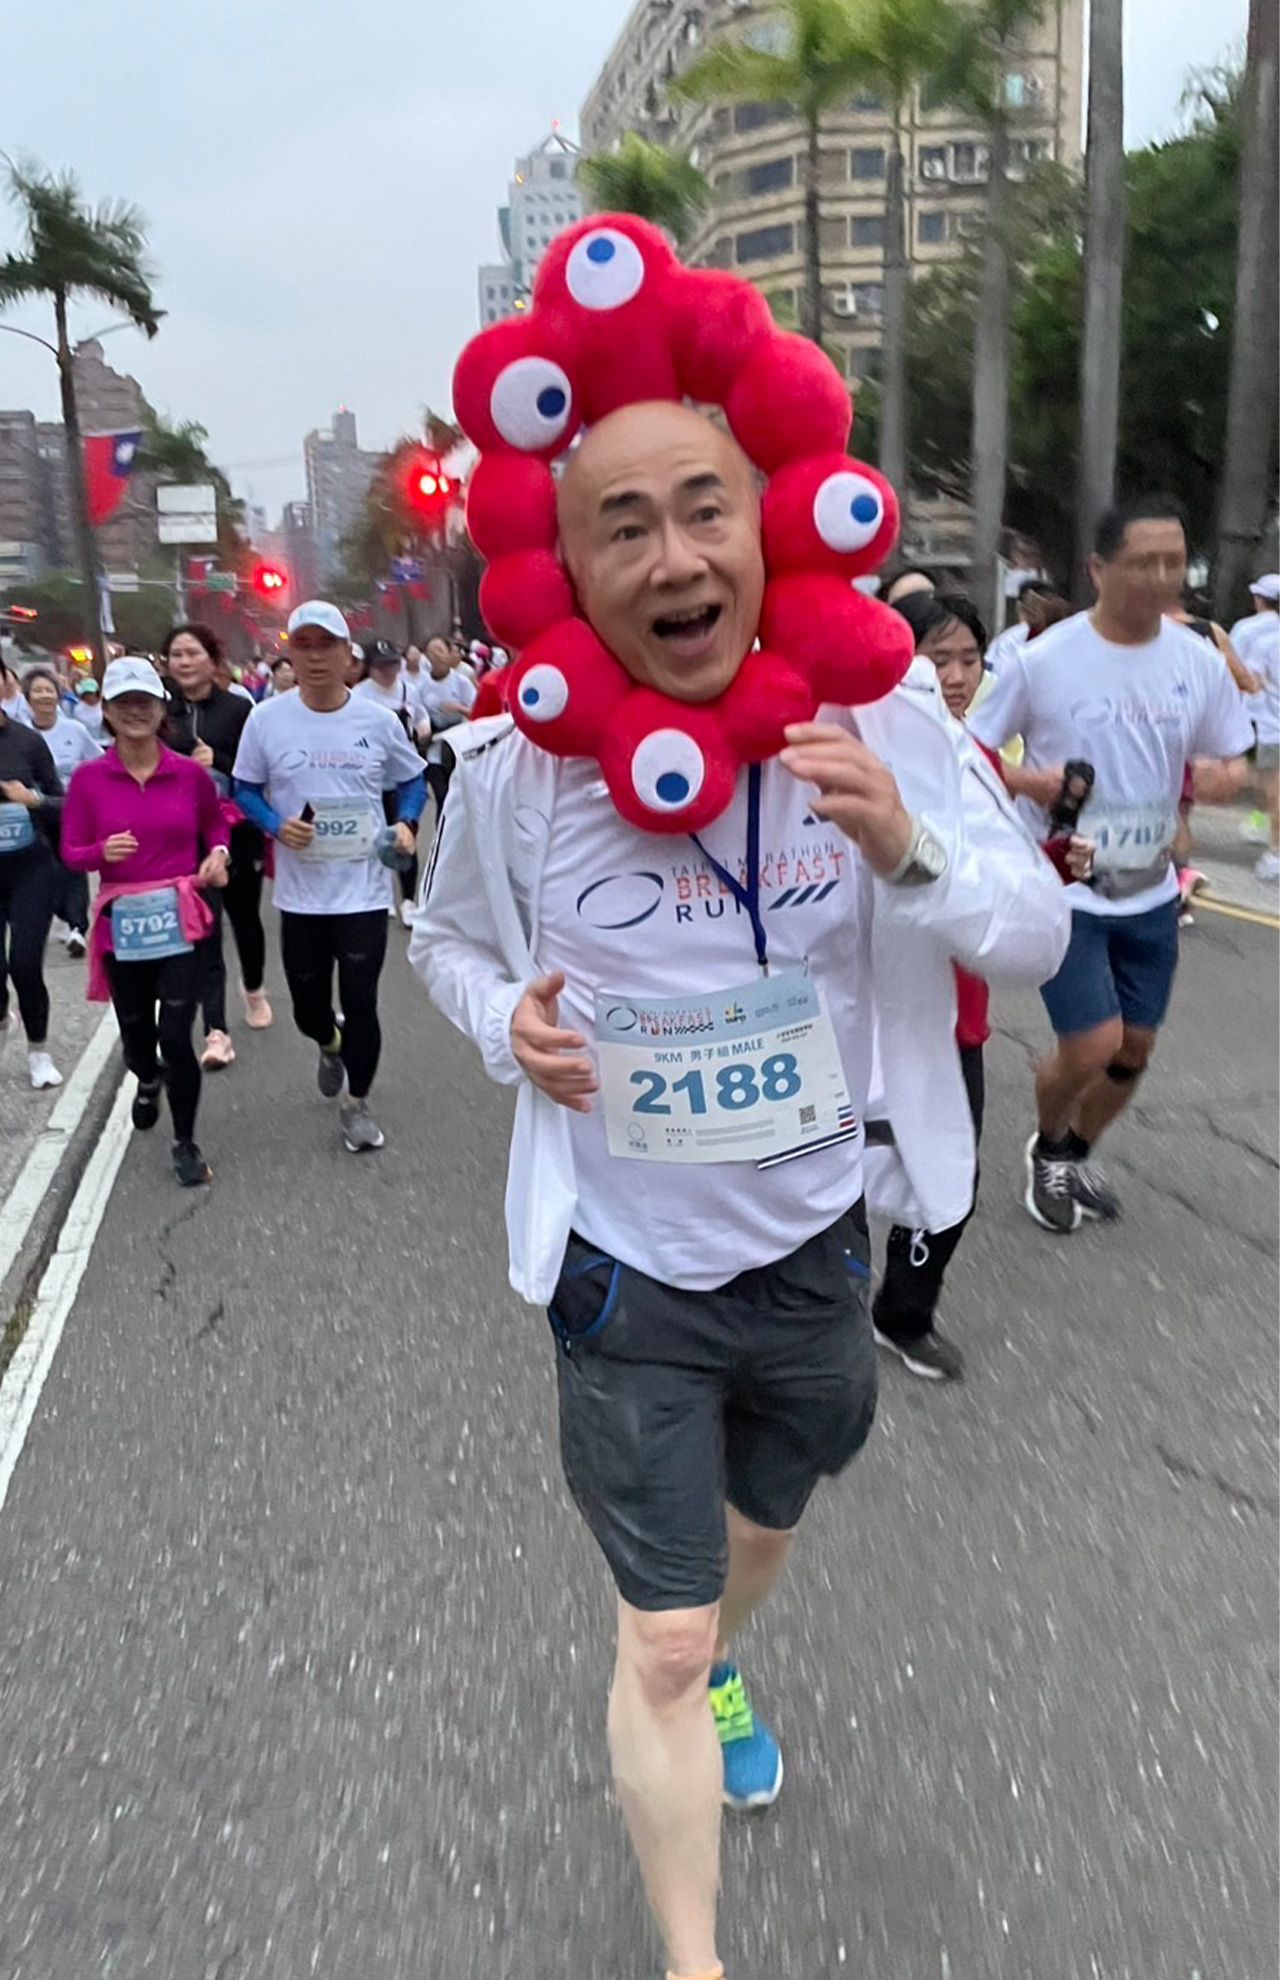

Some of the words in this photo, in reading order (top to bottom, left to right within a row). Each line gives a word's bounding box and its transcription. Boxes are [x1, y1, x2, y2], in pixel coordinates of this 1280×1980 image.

[671, 856, 729, 877] TAIPI
[737, 842, 834, 868] MRATHON
[121, 911, 179, 935] 5792
[640, 1025, 674, 1036] RUN
[653, 1051, 684, 1064] 9KM
[732, 1038, 765, 1055] MALE
[629, 1053, 802, 1115] 2188
